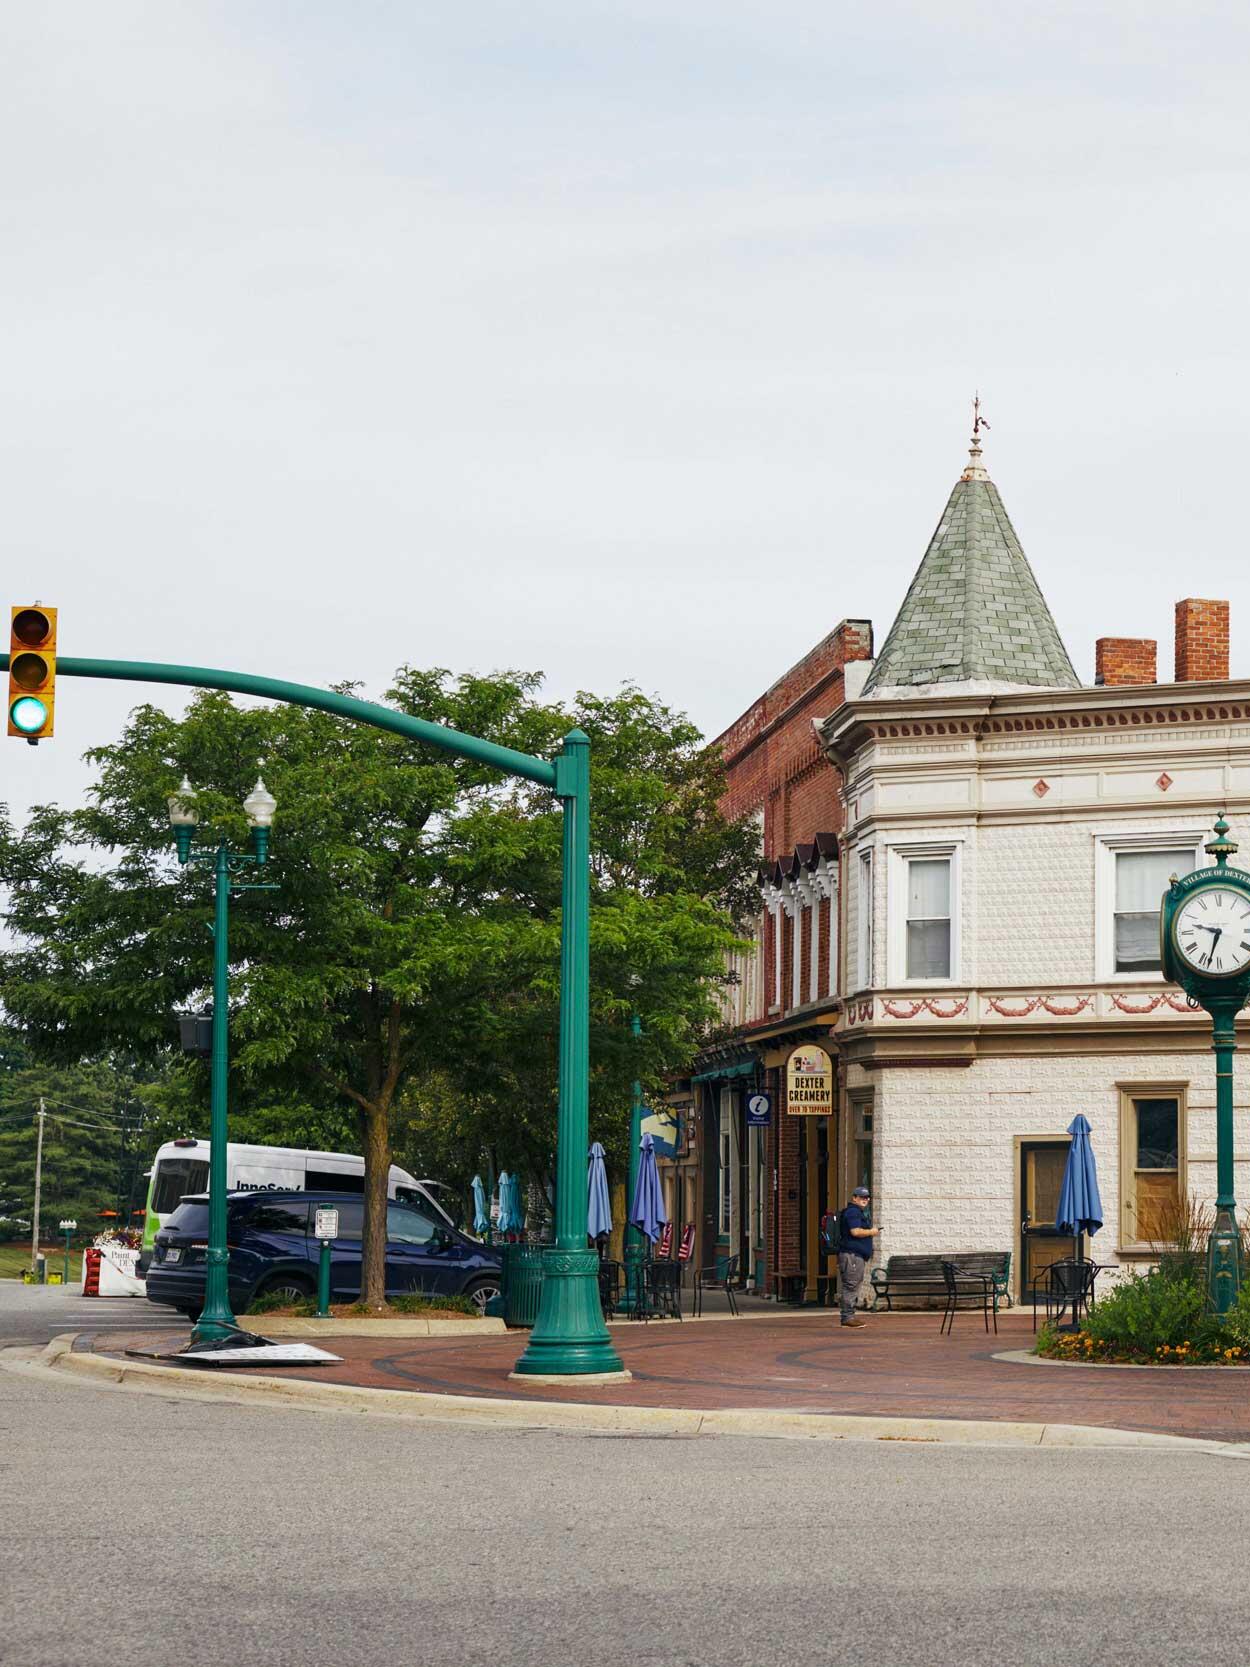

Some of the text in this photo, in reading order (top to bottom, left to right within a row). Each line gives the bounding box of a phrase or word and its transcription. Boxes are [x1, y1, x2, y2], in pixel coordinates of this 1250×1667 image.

[1183, 870, 1213, 887] VILLAGE
[1213, 869, 1223, 877] OF
[795, 1077, 824, 1089] DEXTER
[789, 1090, 830, 1102] CREAMERY
[789, 1105, 801, 1113] OVER
[809, 1105, 831, 1113] TOPPINGS
